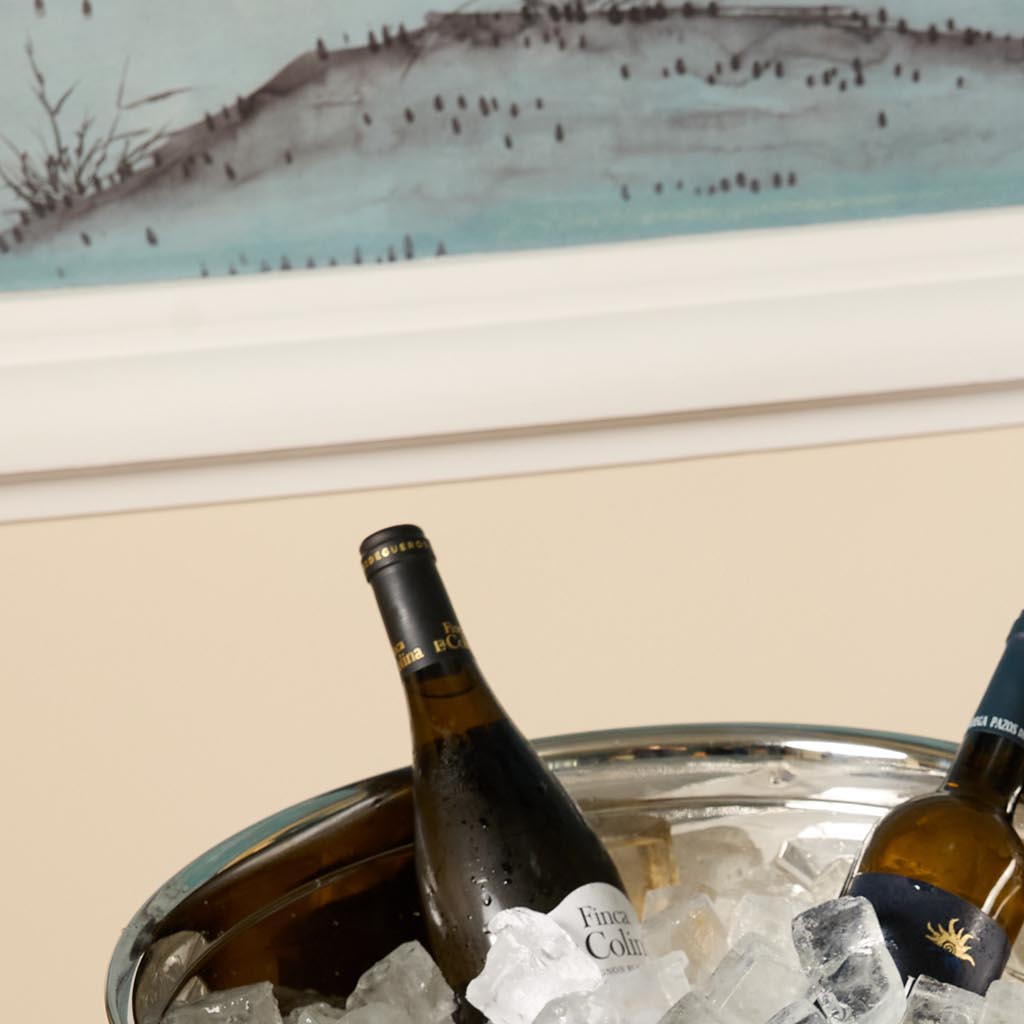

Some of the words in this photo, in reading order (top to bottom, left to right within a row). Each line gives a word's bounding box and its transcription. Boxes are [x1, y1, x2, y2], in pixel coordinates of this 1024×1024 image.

[989, 715, 1019, 736] PAZOS
[577, 905, 631, 929] Finca
[585, 928, 648, 960] Colin
